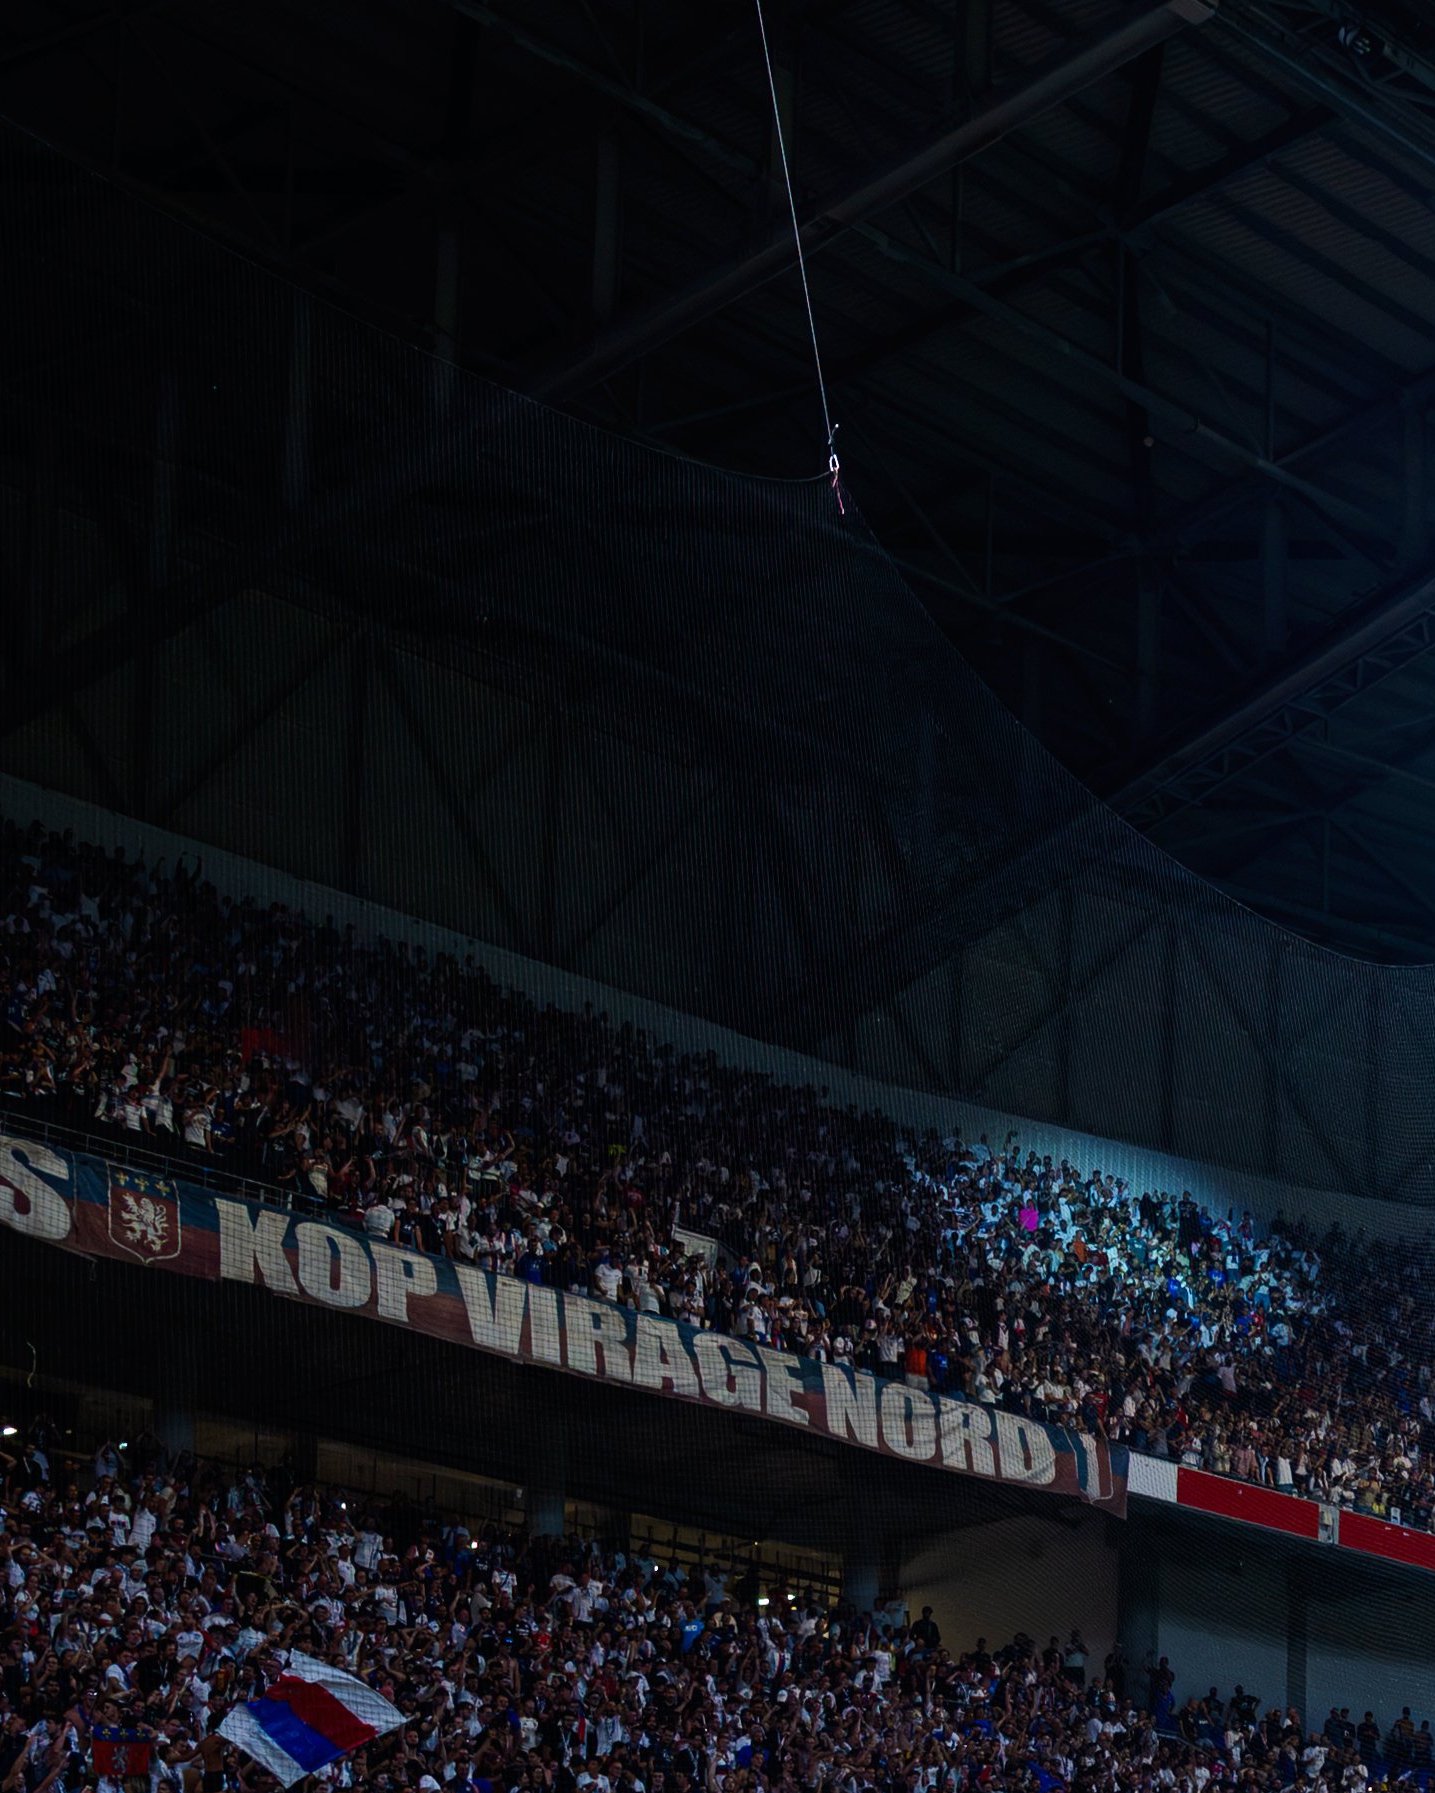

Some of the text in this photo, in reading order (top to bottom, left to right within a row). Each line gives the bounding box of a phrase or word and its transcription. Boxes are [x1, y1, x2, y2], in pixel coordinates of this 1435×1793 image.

[216, 1197, 1057, 1485] KOP VIRAGE NORD
